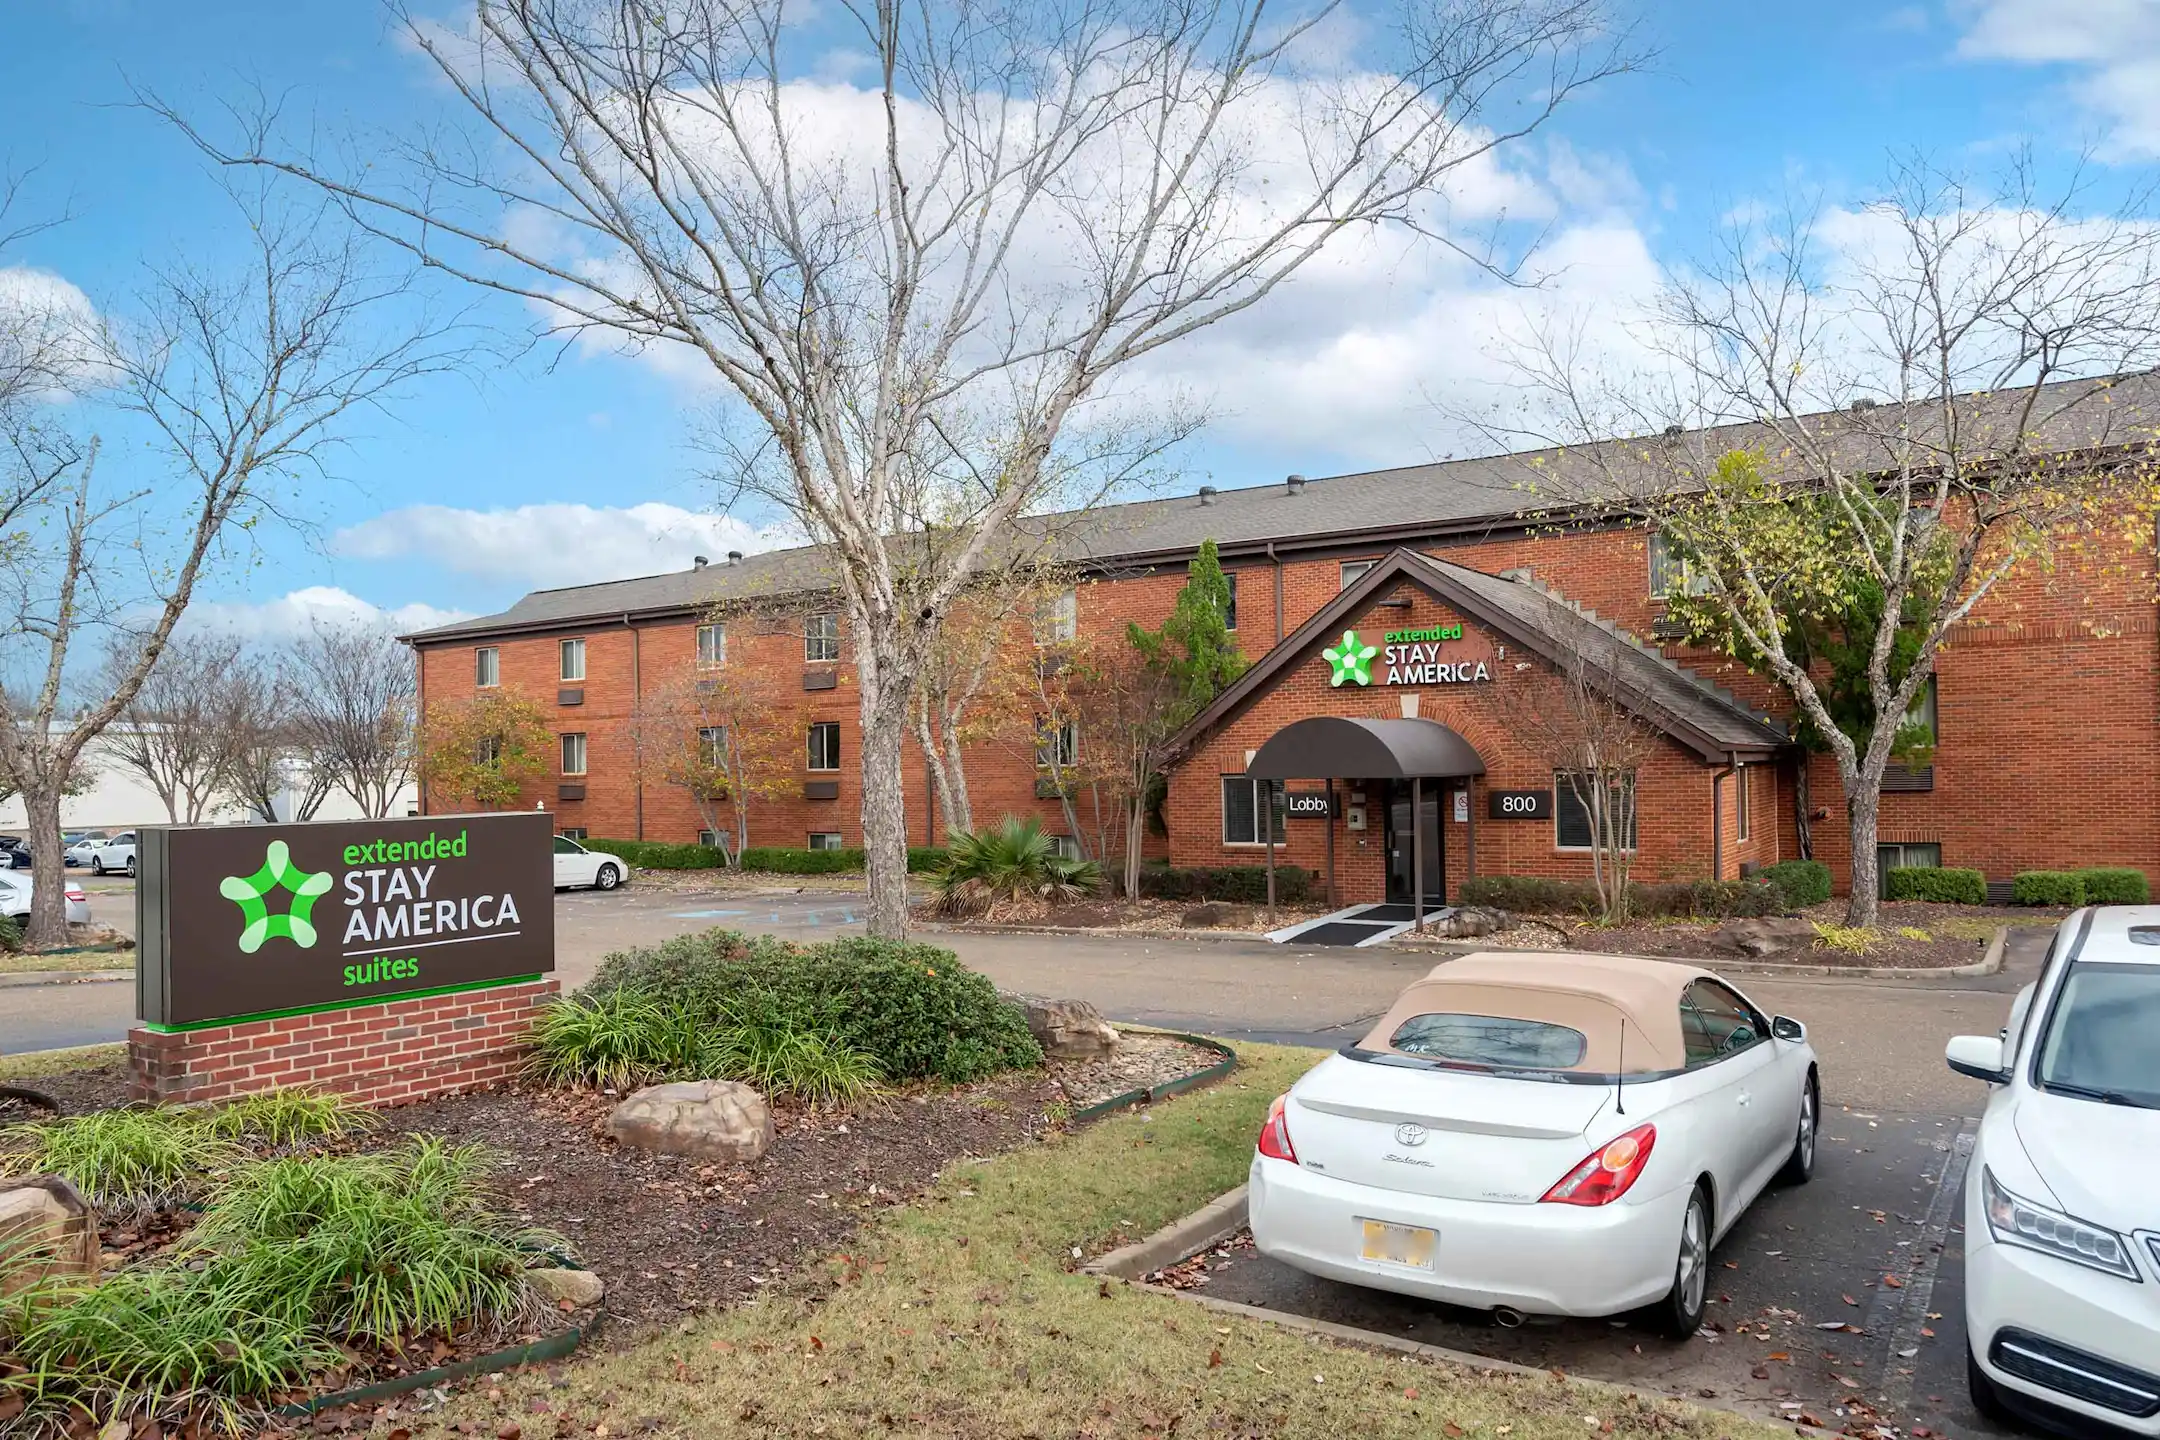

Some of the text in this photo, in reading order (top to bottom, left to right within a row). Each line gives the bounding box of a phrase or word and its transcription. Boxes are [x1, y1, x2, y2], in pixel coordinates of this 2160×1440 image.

[1384, 624, 1463, 643] extended
[1385, 643, 1440, 665] STAY
[1386, 662, 1491, 685] AMERICA
[1502, 796, 1537, 813] 800
[343, 830, 467, 865] extended
[343, 865, 436, 906] STAY
[342, 894, 521, 944] AMERICA
[343, 956, 419, 986] suites
